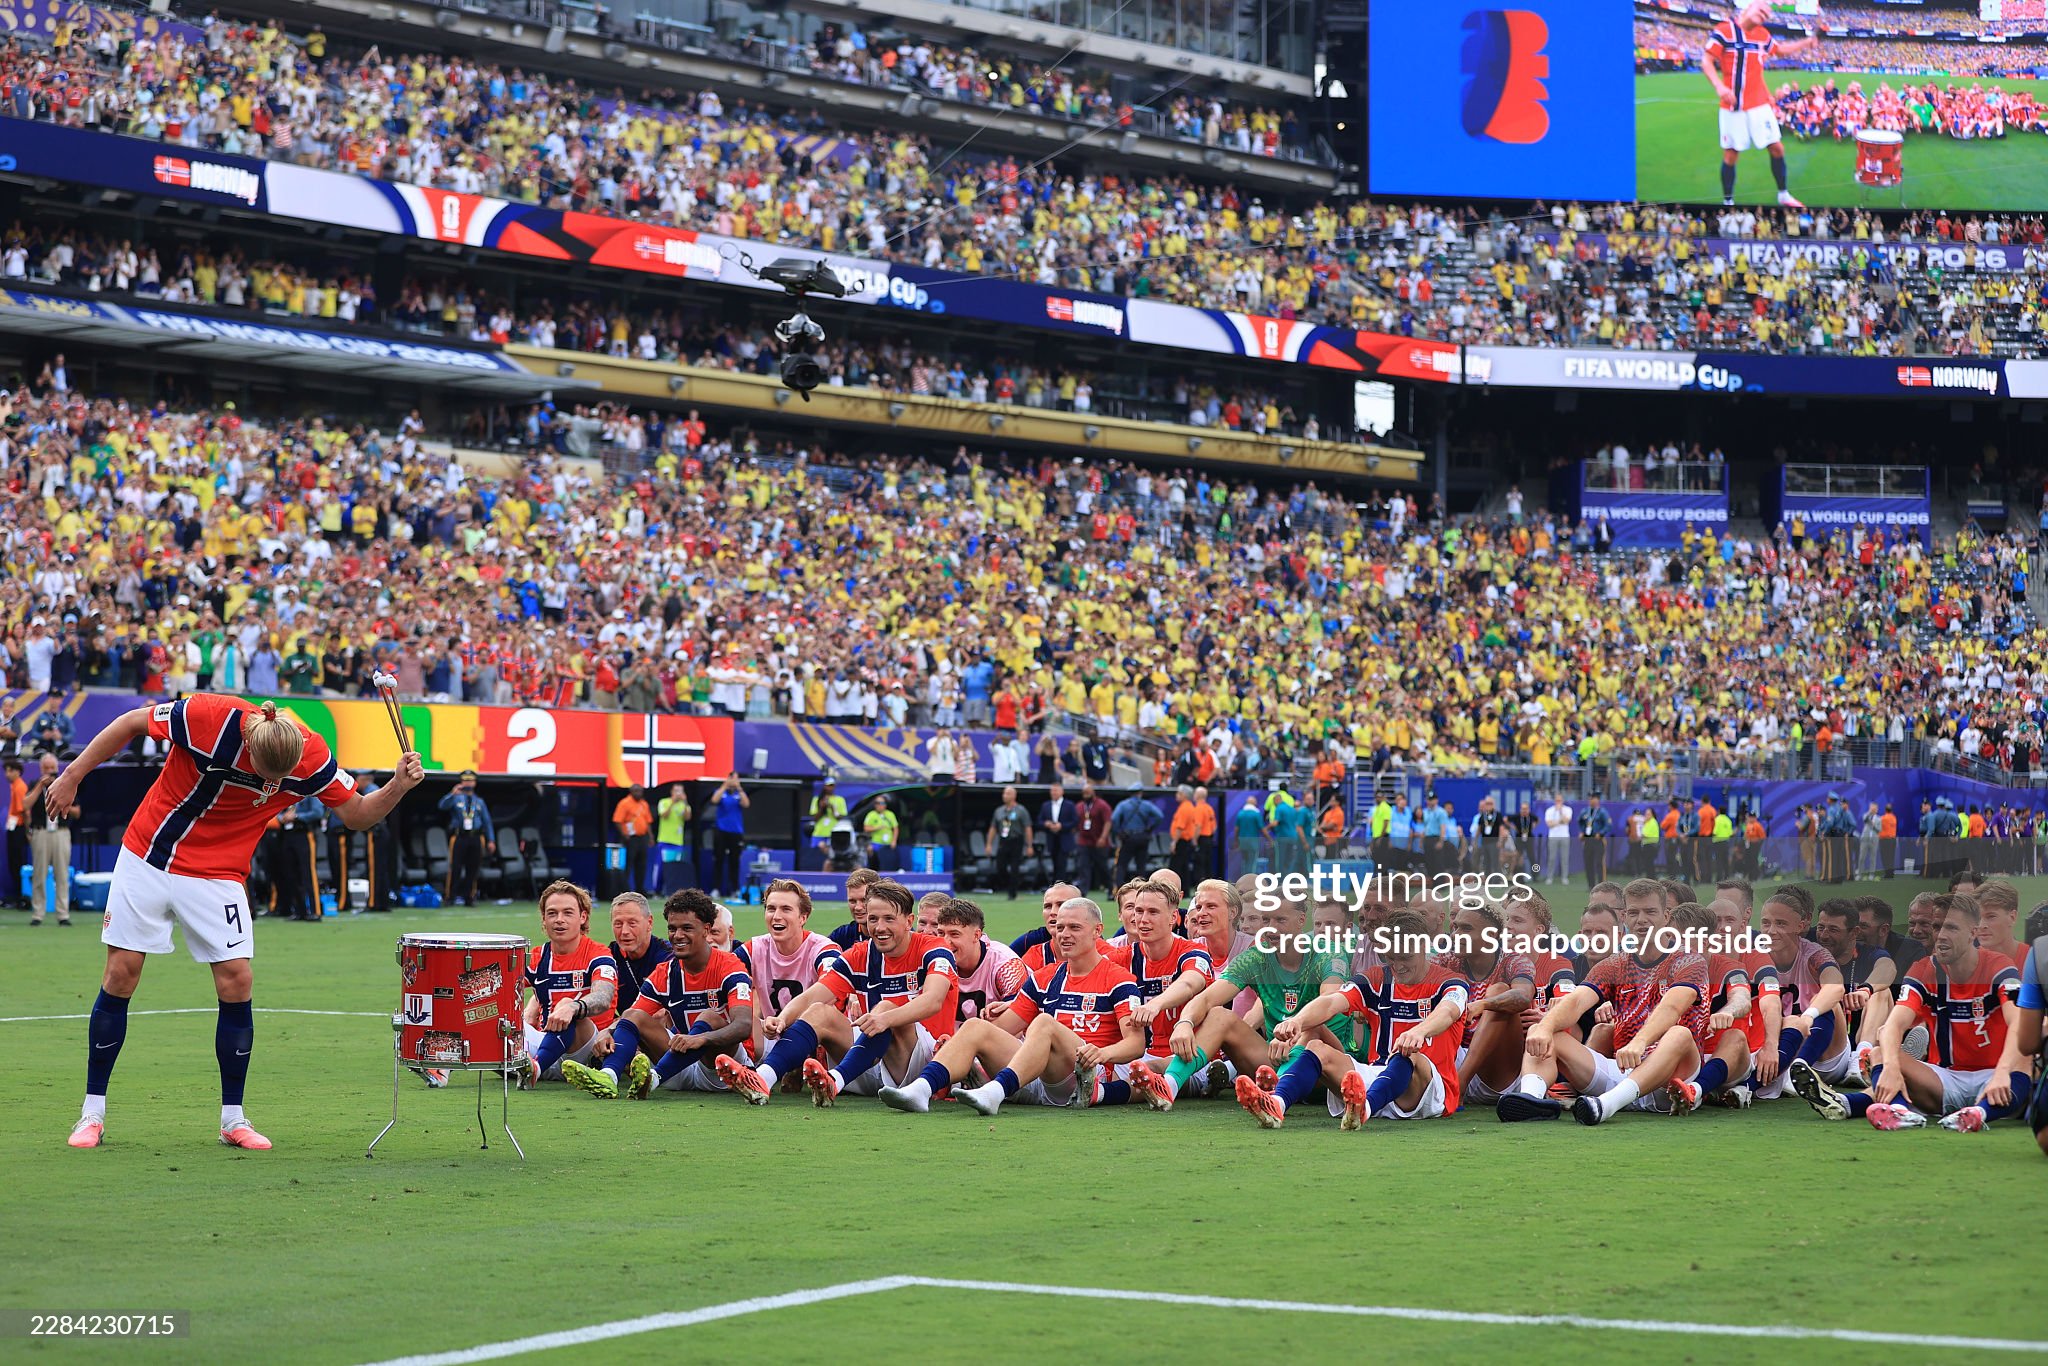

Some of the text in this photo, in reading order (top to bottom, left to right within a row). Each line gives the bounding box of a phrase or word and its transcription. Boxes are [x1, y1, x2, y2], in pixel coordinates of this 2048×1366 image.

[1564, 357, 1613, 379] FIFA
[1614, 358, 1696, 386] WORLD
[1932, 366, 1998, 396] NORWAY
[1581, 506, 1728, 522] FIFA WORLD CUP 2026
[1811, 510, 1858, 524] WORLD
[1859, 511, 1885, 524] CUP
[1885, 512, 1930, 525] 2026
[507, 708, 557, 775] 2
[224, 903, 243, 934] 9
[1973, 1020, 1991, 1048] 3
